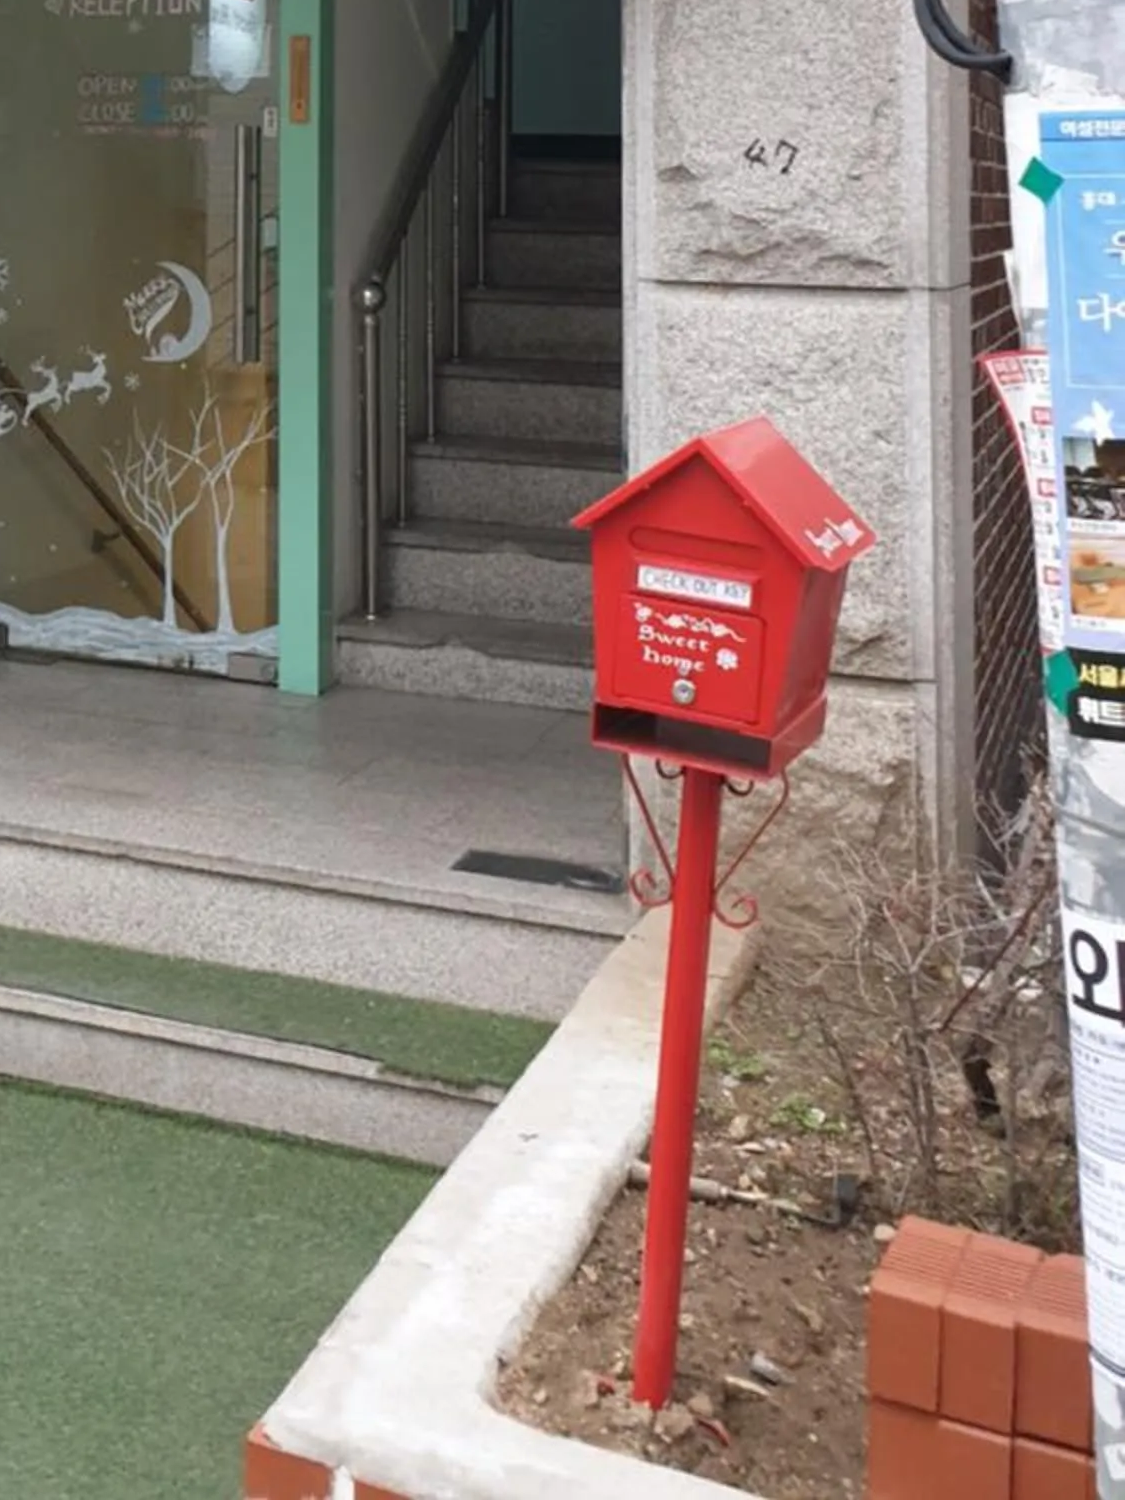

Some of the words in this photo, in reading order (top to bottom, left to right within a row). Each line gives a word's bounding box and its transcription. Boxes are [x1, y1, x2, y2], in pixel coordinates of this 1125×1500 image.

[78, 75, 138, 96] OPEN
[79, 101, 137, 122] CLOSE
[744, 137, 799, 175] 47
[638, 624, 710, 652] Sweet
[642, 645, 706, 672] home
